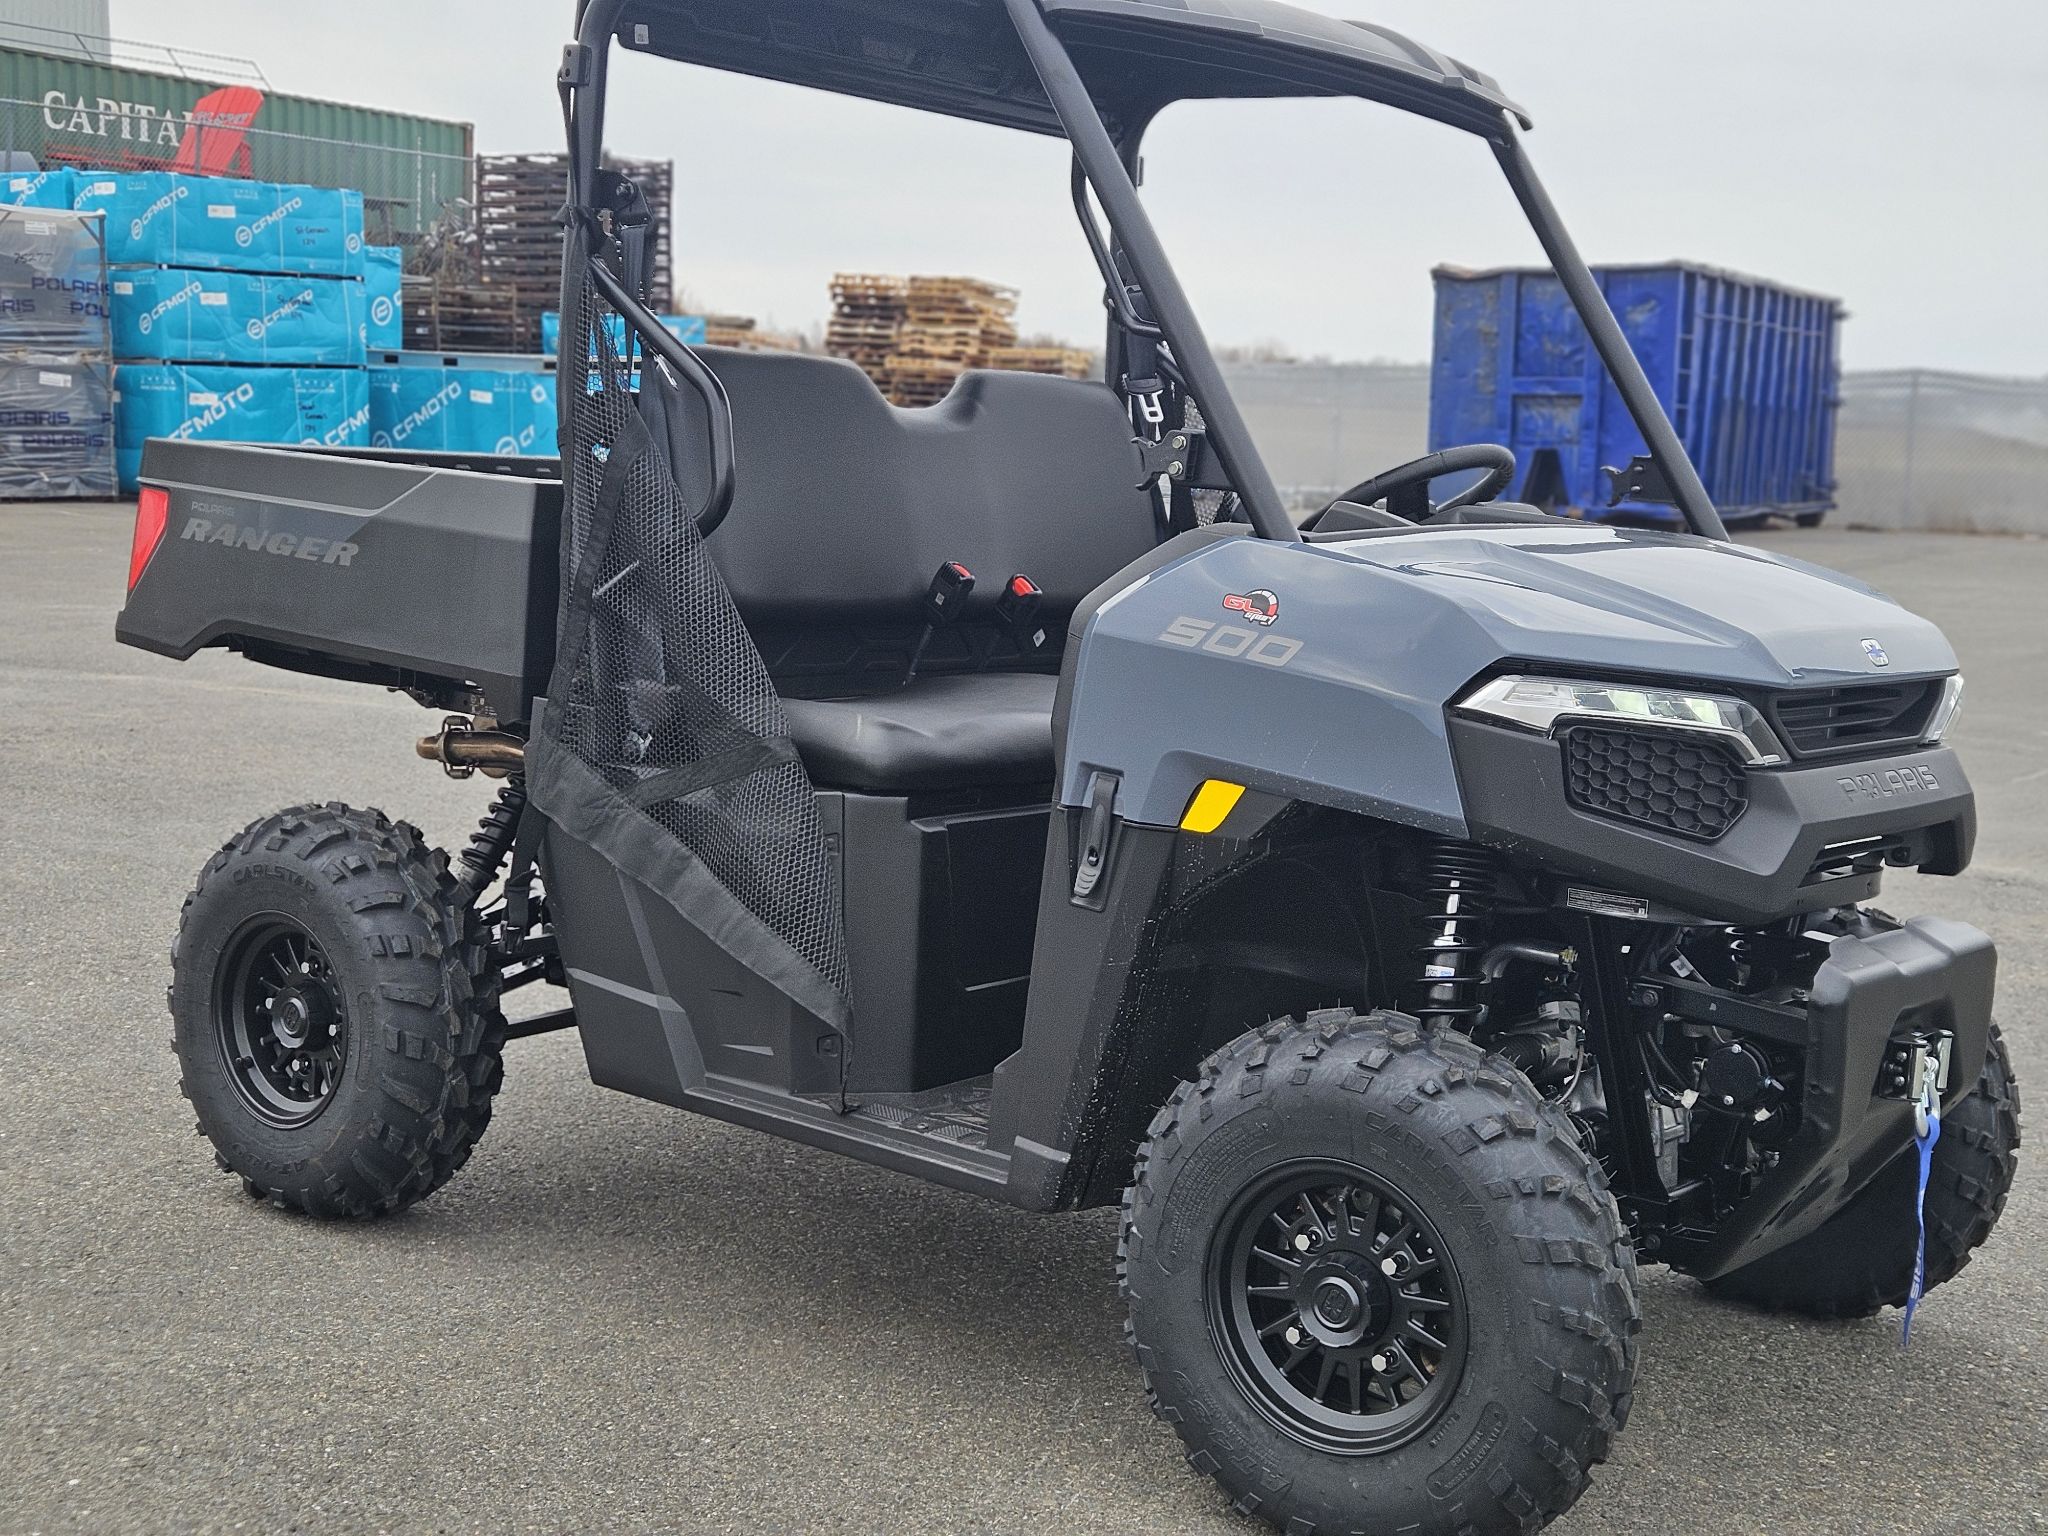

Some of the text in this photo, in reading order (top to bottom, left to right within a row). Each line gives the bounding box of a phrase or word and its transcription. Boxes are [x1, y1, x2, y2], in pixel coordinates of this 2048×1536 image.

[142, 186, 189, 225] CFMOTO
[251, 196, 302, 235] CFMOTO
[151, 280, 202, 321] CFMOTO
[263, 288, 313, 328] CFMOTO
[392, 381, 462, 441] CFMOTO
[191, 501, 235, 518] POLARIS
[180, 517, 359, 567] RANGER
[1158, 616, 1305, 667] 500
[1836, 764, 1940, 802] POLARIS
